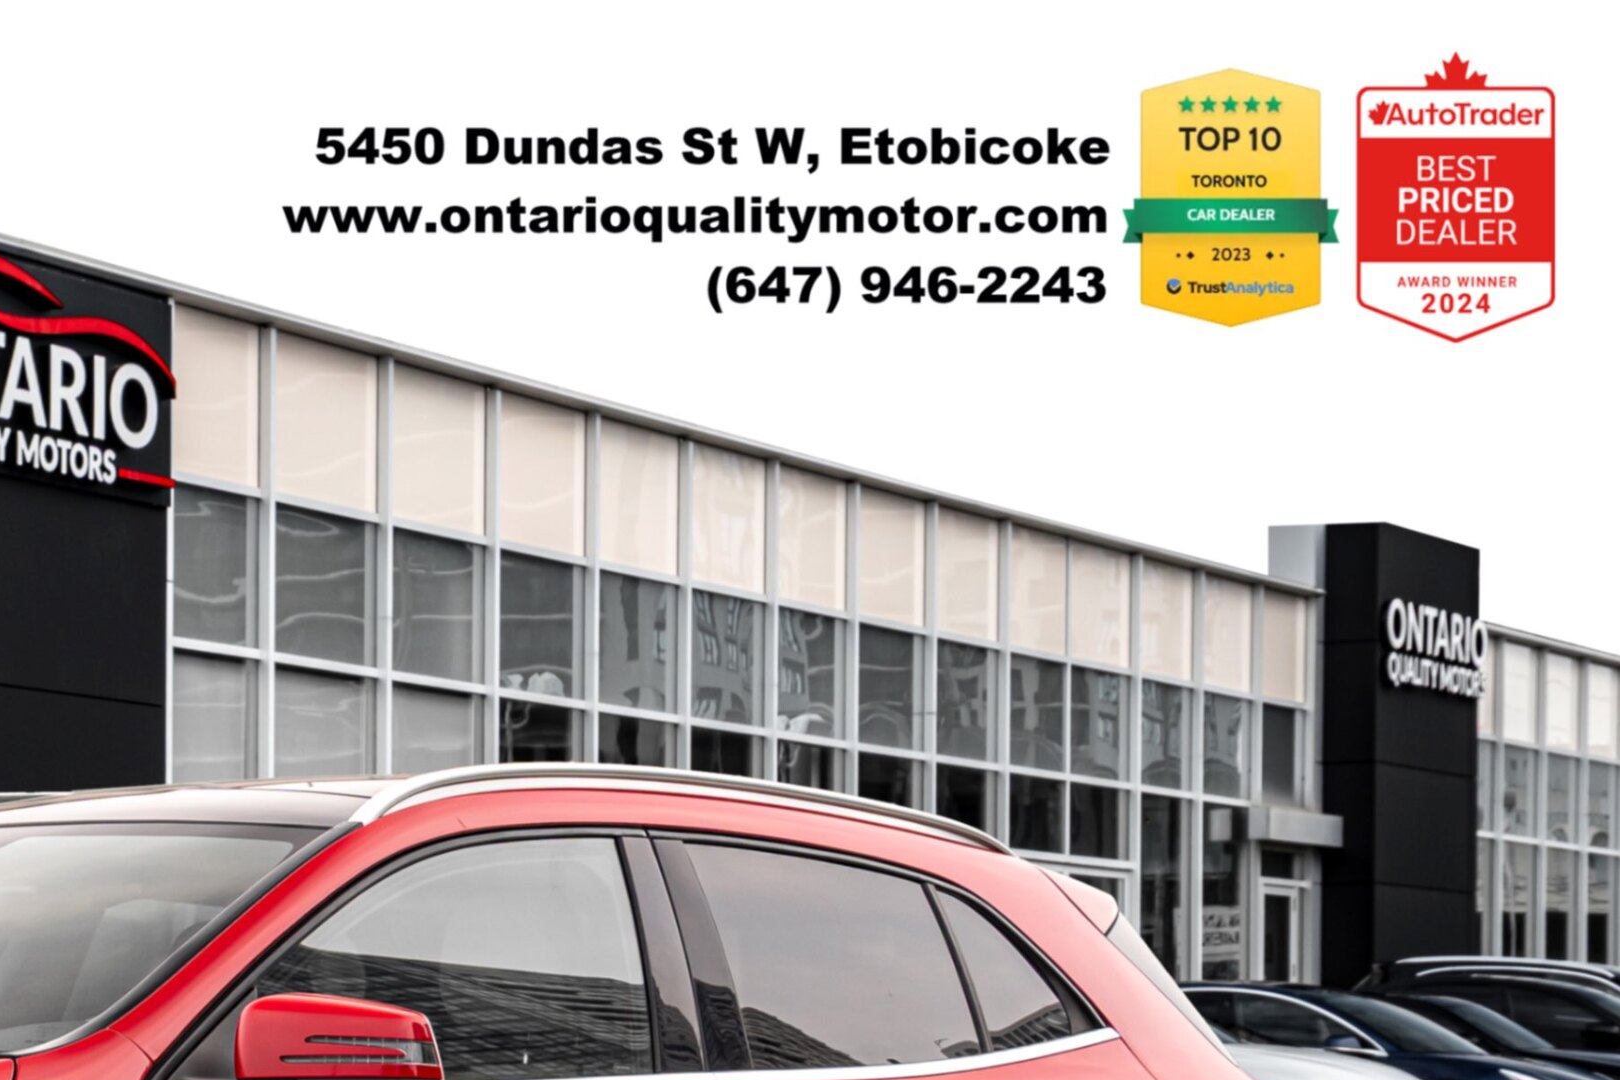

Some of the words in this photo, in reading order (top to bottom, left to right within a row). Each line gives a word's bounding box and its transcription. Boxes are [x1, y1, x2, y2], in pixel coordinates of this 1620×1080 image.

[17, 429, 117, 484] MOTORS
[1387, 597, 1488, 667] ONTARIO
[1387, 651, 1439, 688] QUALITY
